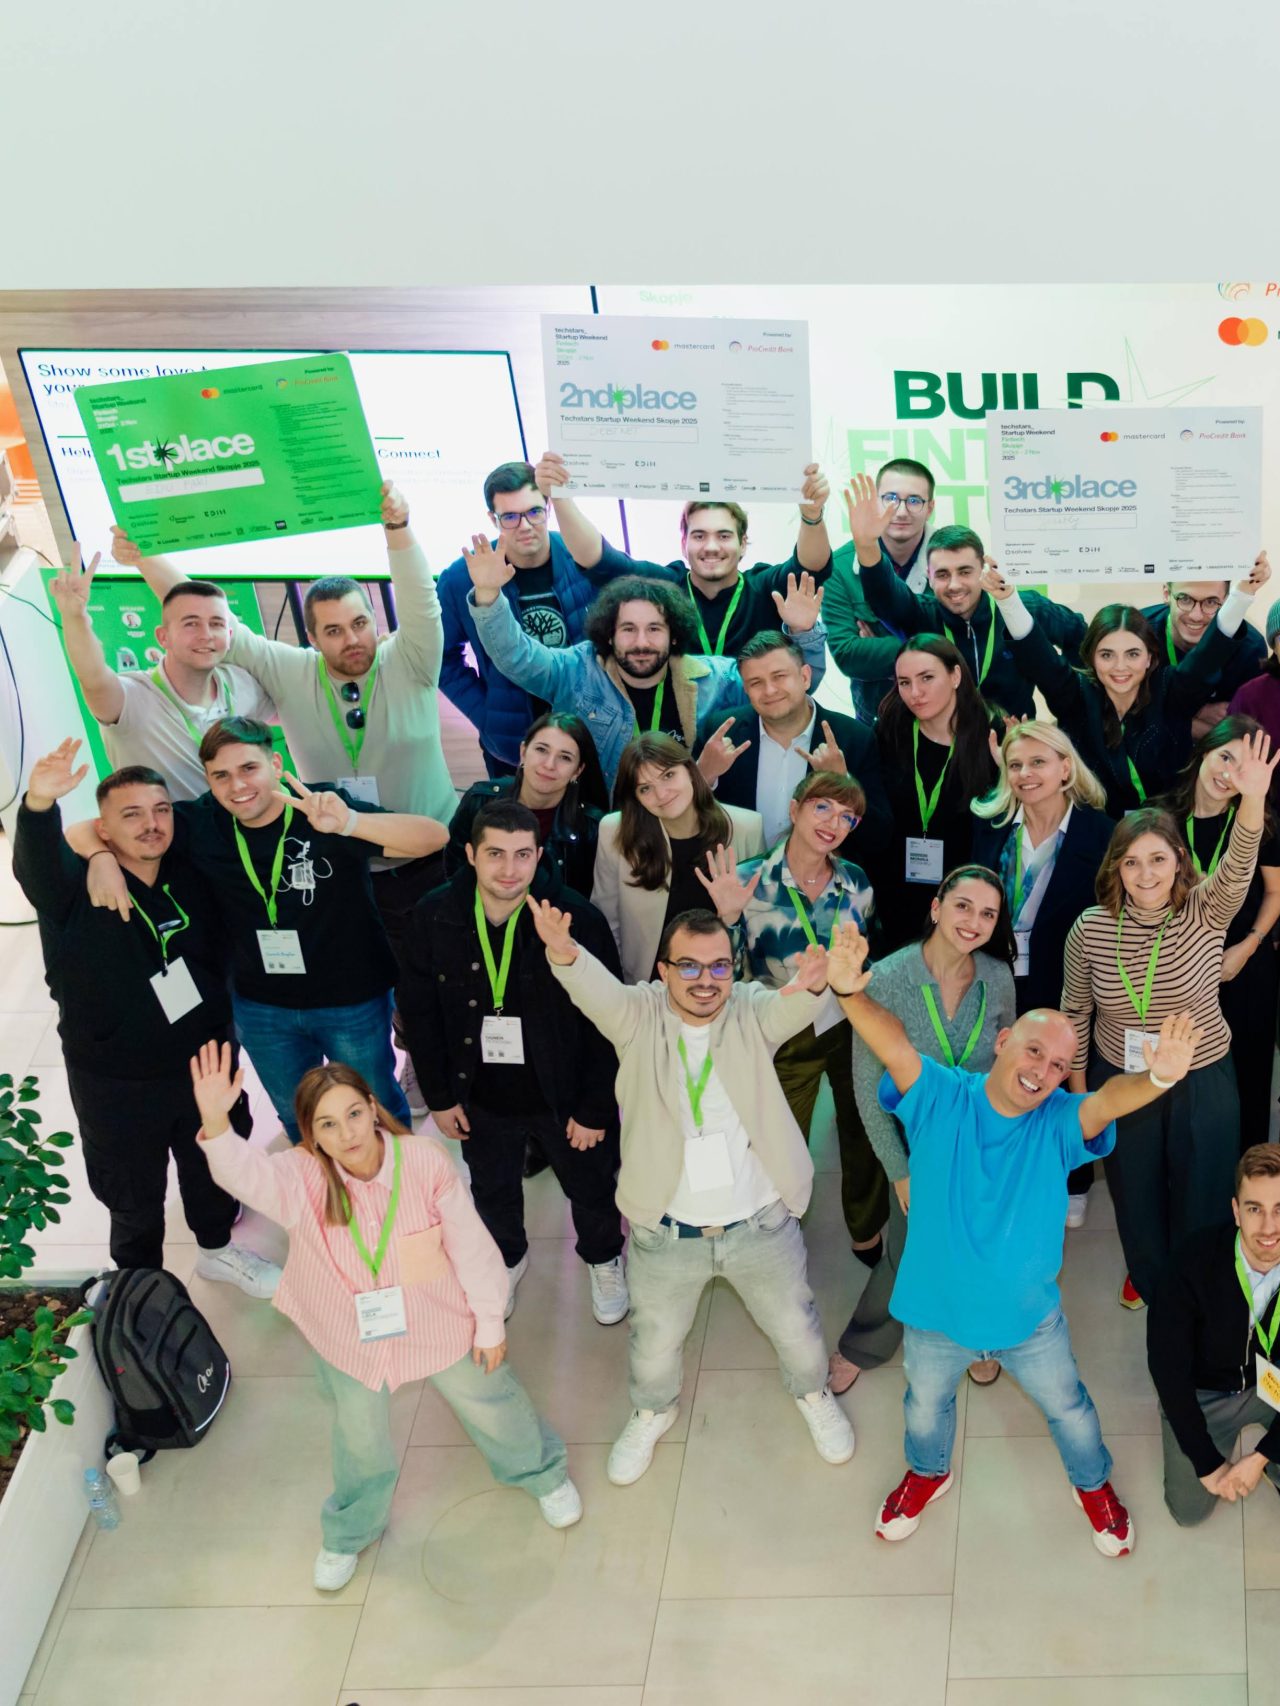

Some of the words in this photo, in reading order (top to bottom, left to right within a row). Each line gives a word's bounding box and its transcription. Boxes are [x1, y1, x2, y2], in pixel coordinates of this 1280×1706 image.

[38, 363, 91, 377] Show
[98, 367, 151, 378] some
[560, 382, 613, 409] 2nd
[616, 383, 697, 415] place
[595, 415, 622, 423] Startup
[622, 416, 655, 424] Weekend
[656, 417, 680, 425] Skopje
[106, 438, 162, 471] 1st
[163, 433, 255, 472] place
[378, 448, 440, 459] Connect
[1004, 475, 1052, 500] 3rd
[1055, 474, 1137, 504] place
